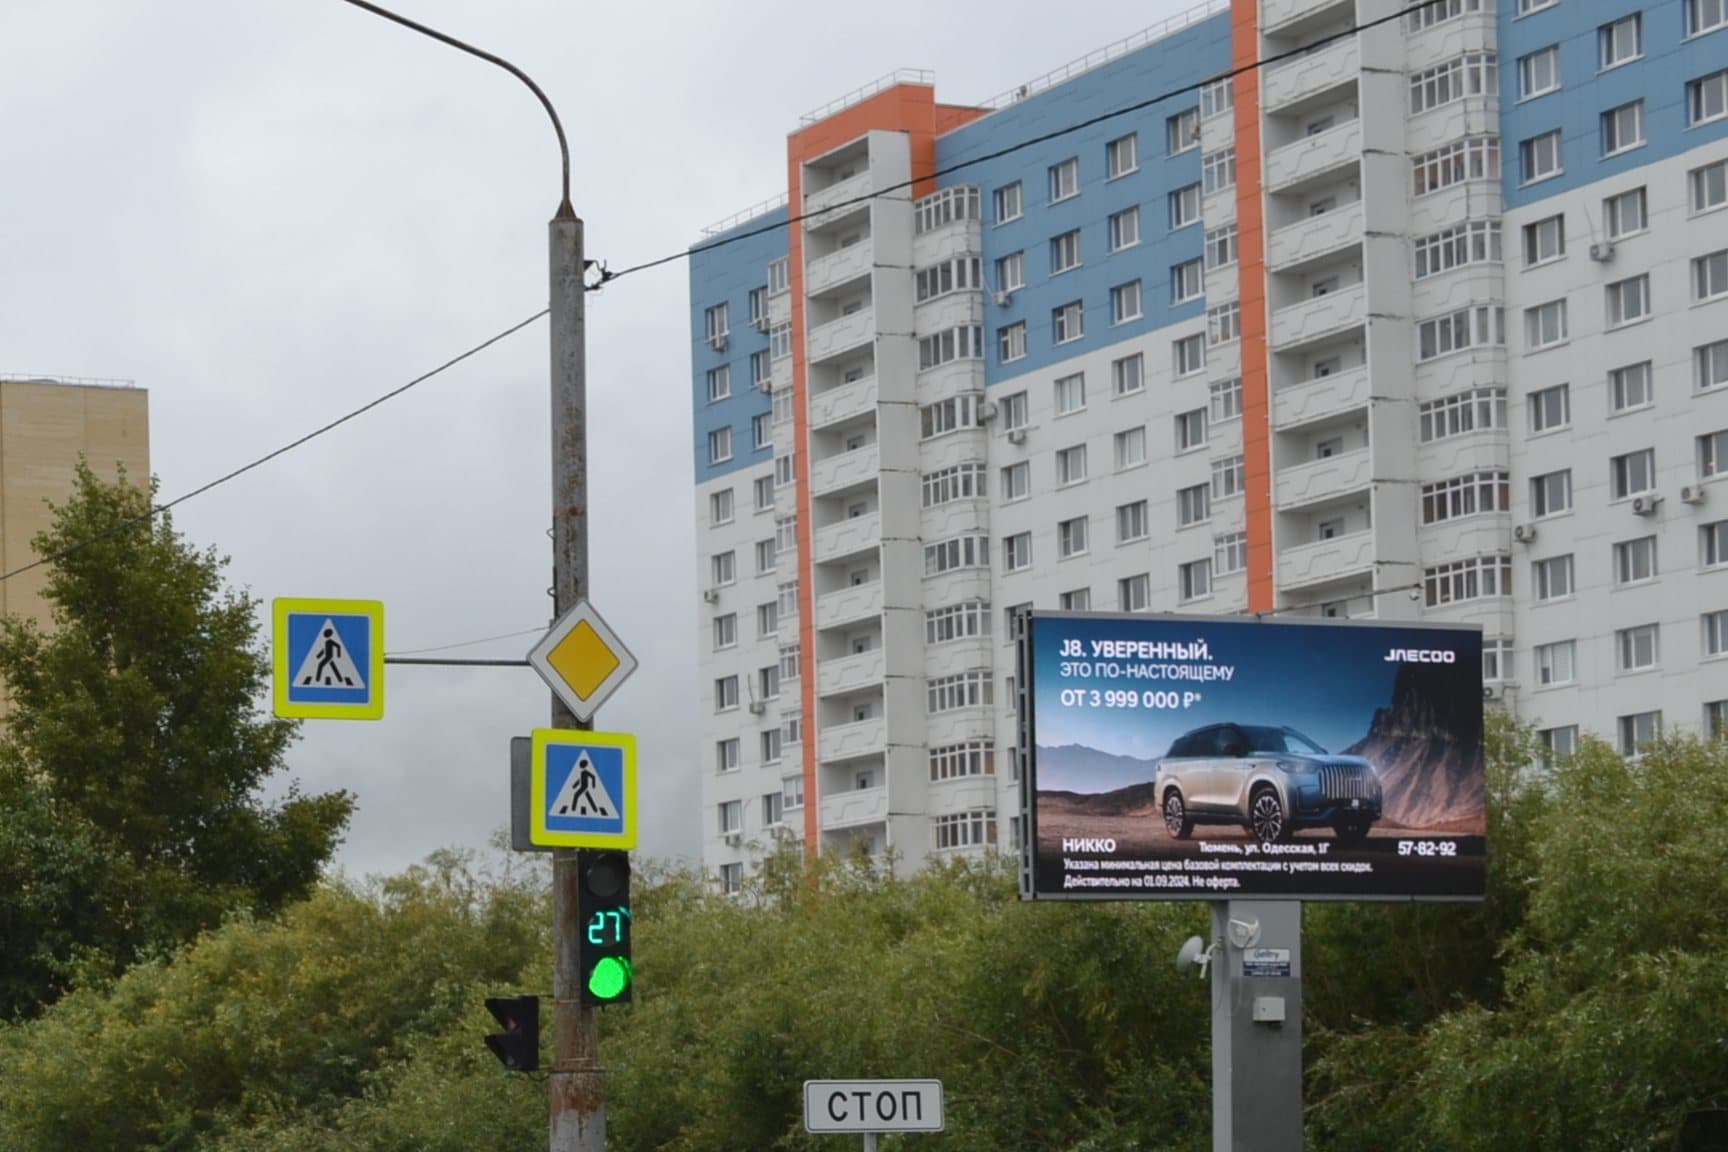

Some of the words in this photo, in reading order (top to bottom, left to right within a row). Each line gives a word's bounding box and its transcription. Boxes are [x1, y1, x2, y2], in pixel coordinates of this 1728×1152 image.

[1059, 639, 1087, 658] J8.
[1091, 638, 1214, 661] УВЕРЕННЫЙ.
[1383, 648, 1456, 664] JAECOO
[1059, 661, 1092, 678] ЭТО
[1095, 662, 1235, 683] ПО-НАСТОЯЩЕМУ
[1060, 689, 1087, 707] ОТ
[1089, 690, 1101, 708] 3
[1104, 690, 1139, 709] 999
[1142, 690, 1180, 709] 000
[1062, 838, 1117, 854] НИККО
[1198, 841, 1243, 855] Тюмень,
[1262, 842, 1317, 856] Одесская,
[1397, 840, 1457, 857] 57-82-92
[588, 911, 621, 944] 27
[828, 1090, 922, 1122] СТОП
